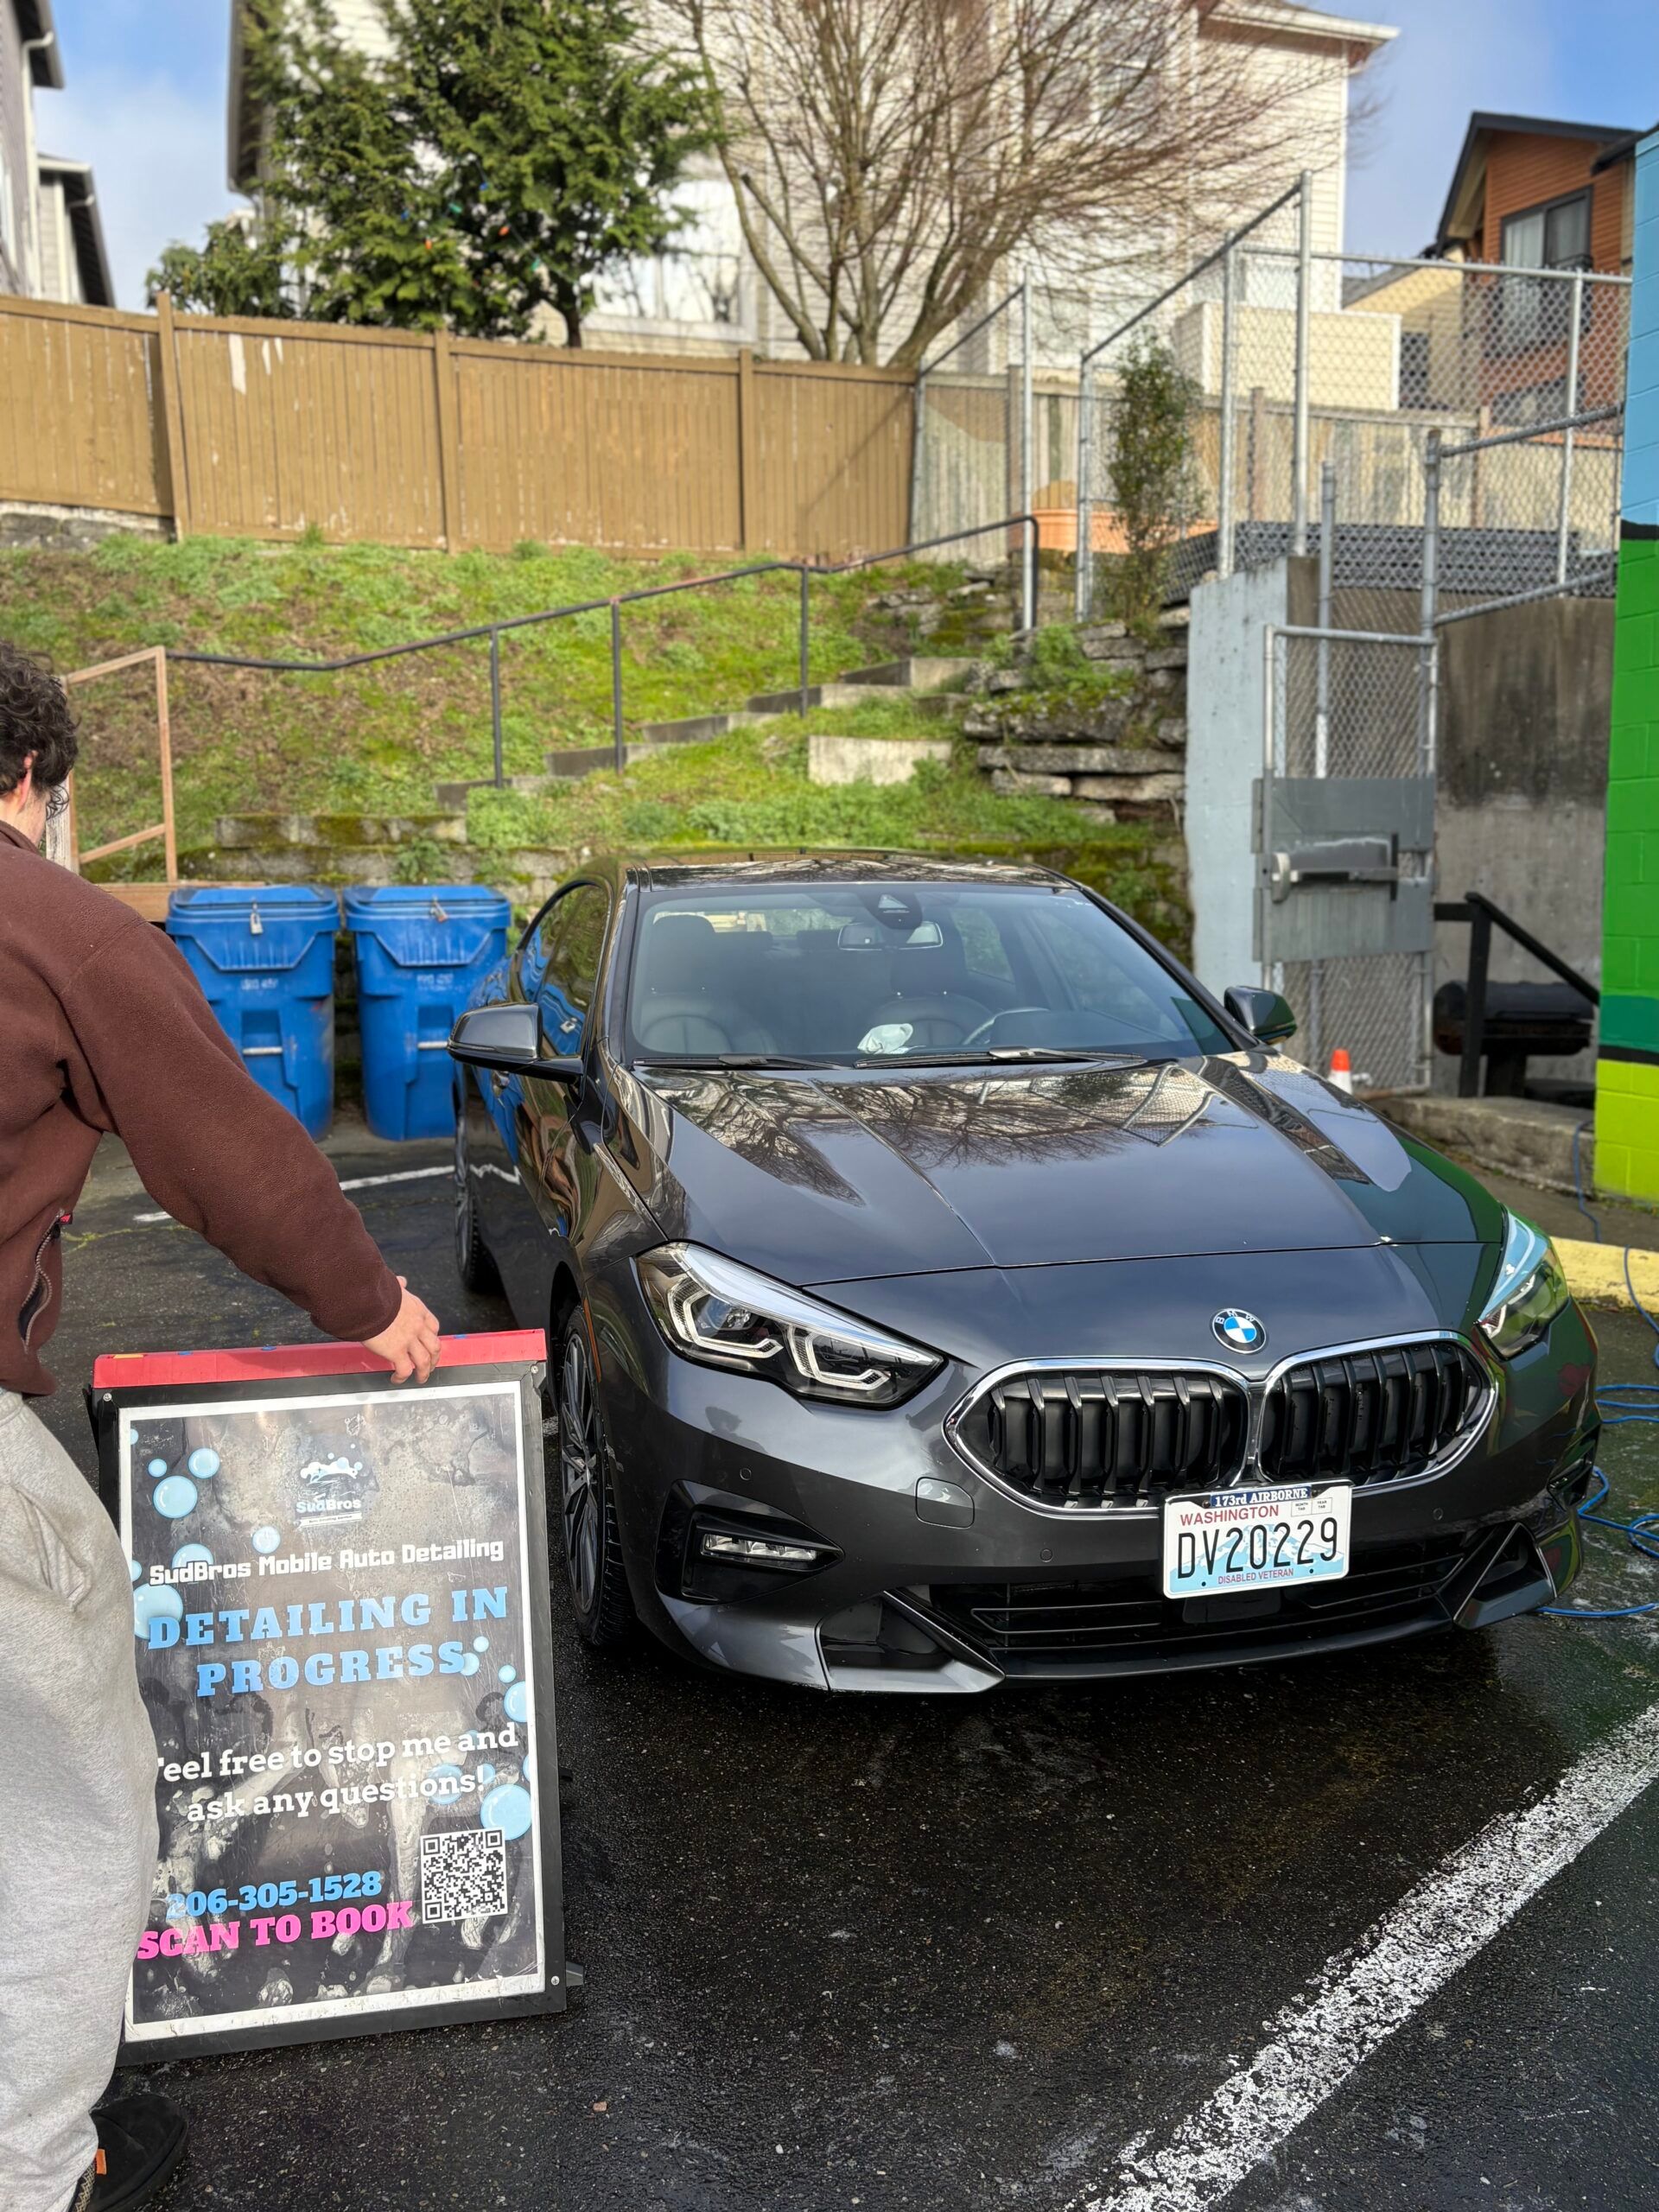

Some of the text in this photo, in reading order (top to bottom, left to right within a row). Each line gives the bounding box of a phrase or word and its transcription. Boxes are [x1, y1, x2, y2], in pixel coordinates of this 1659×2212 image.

[1215, 1309, 1255, 1325] BMW
[296, 1498, 361, 1514] SudBros
[1180, 1504, 1279, 1527] WASHINGTON
[1215, 1488, 1308, 1507] 173rd AIRBORNE
[149, 1538, 504, 1586] SudBros Mobile Auto Detailing
[1178, 1517, 1338, 1580] DV20229
[1217, 1567, 1294, 1585] DISABLED VETERAN
[148, 1586, 508, 1649] DETAILING IN
[196, 1641, 465, 1697] PROGRESS
[157, 1722, 518, 1783] eel free to stop me and
[187, 1765, 485, 1822] ask any questions!
[166, 1871, 383, 1920] 206-305-1528
[137, 1901, 414, 1960] SCAN TO BOOK
